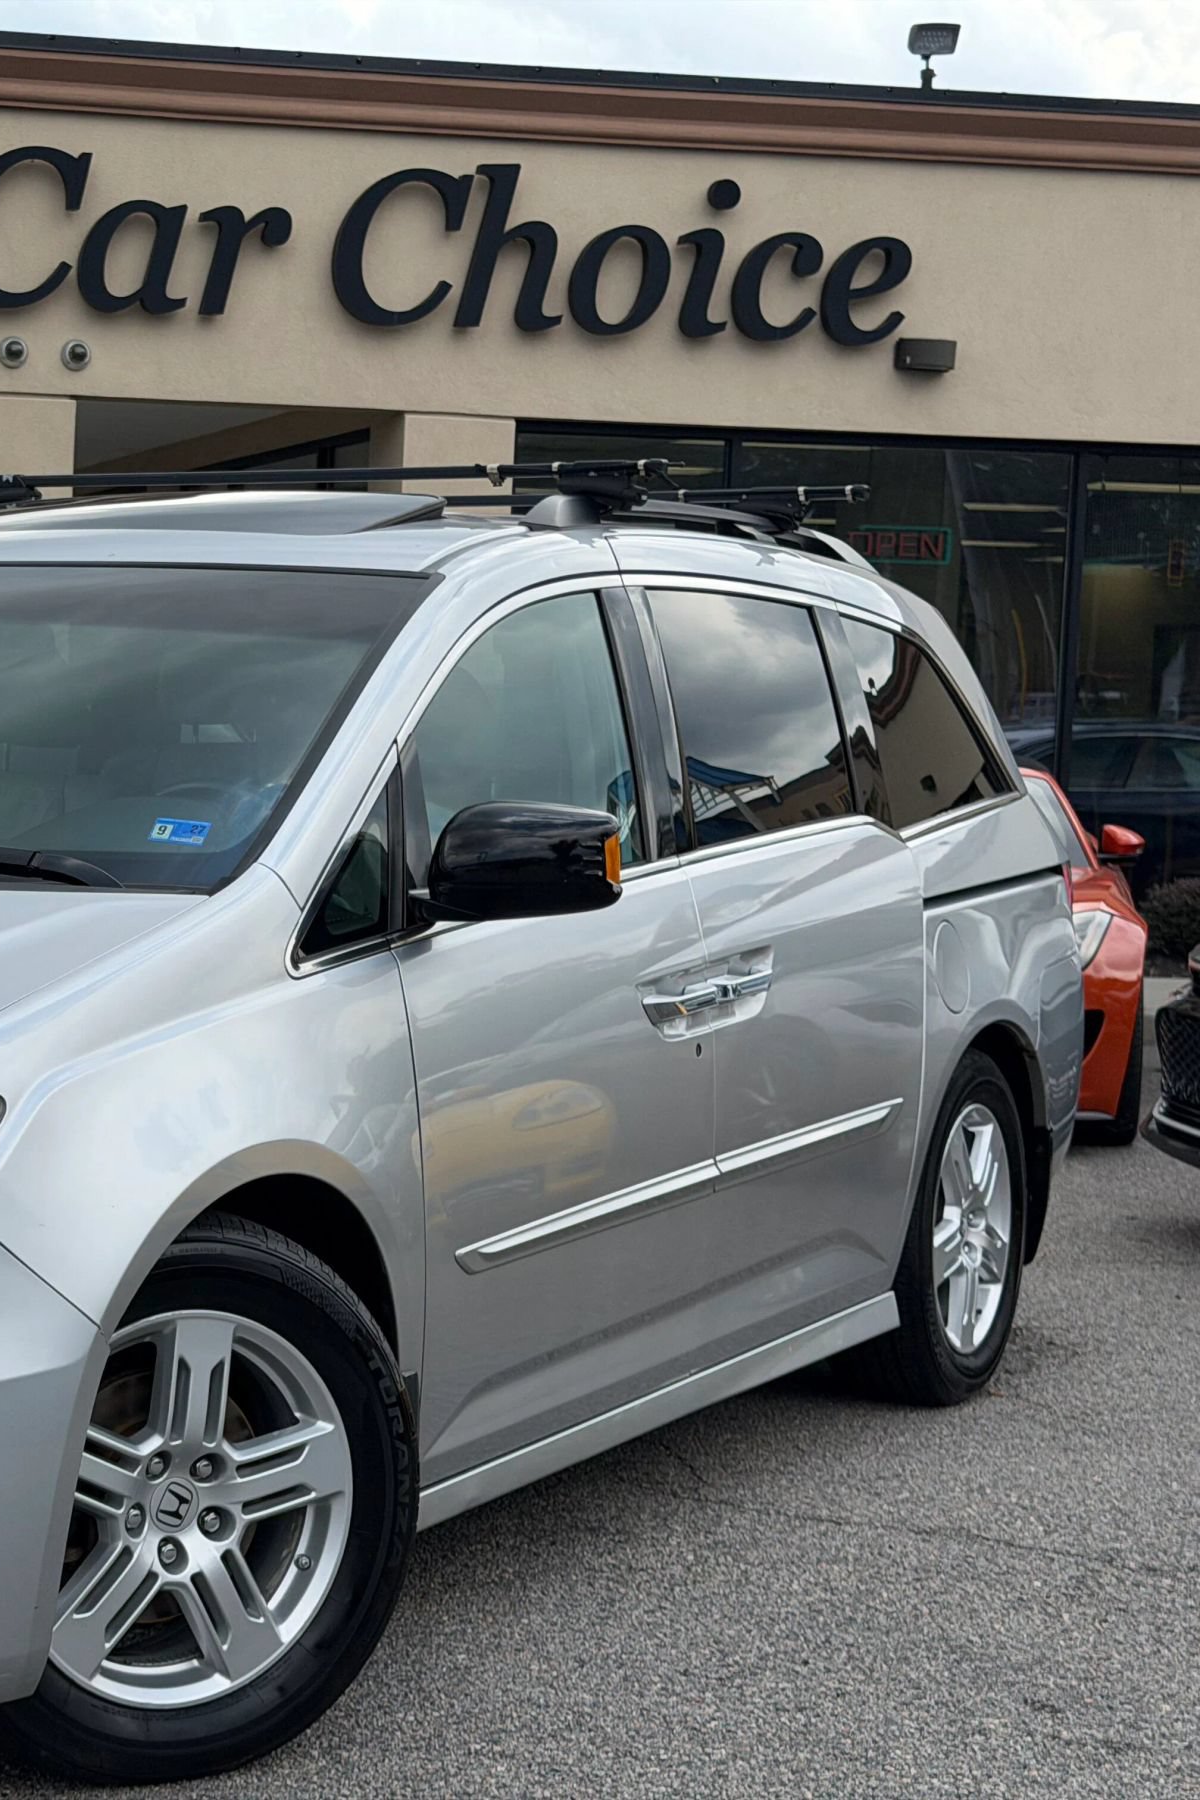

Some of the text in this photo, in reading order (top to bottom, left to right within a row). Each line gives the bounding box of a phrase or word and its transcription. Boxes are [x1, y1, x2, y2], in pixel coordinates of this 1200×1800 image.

[330, 163, 913, 347] Choice
[156, 824, 207, 836] 9 27
